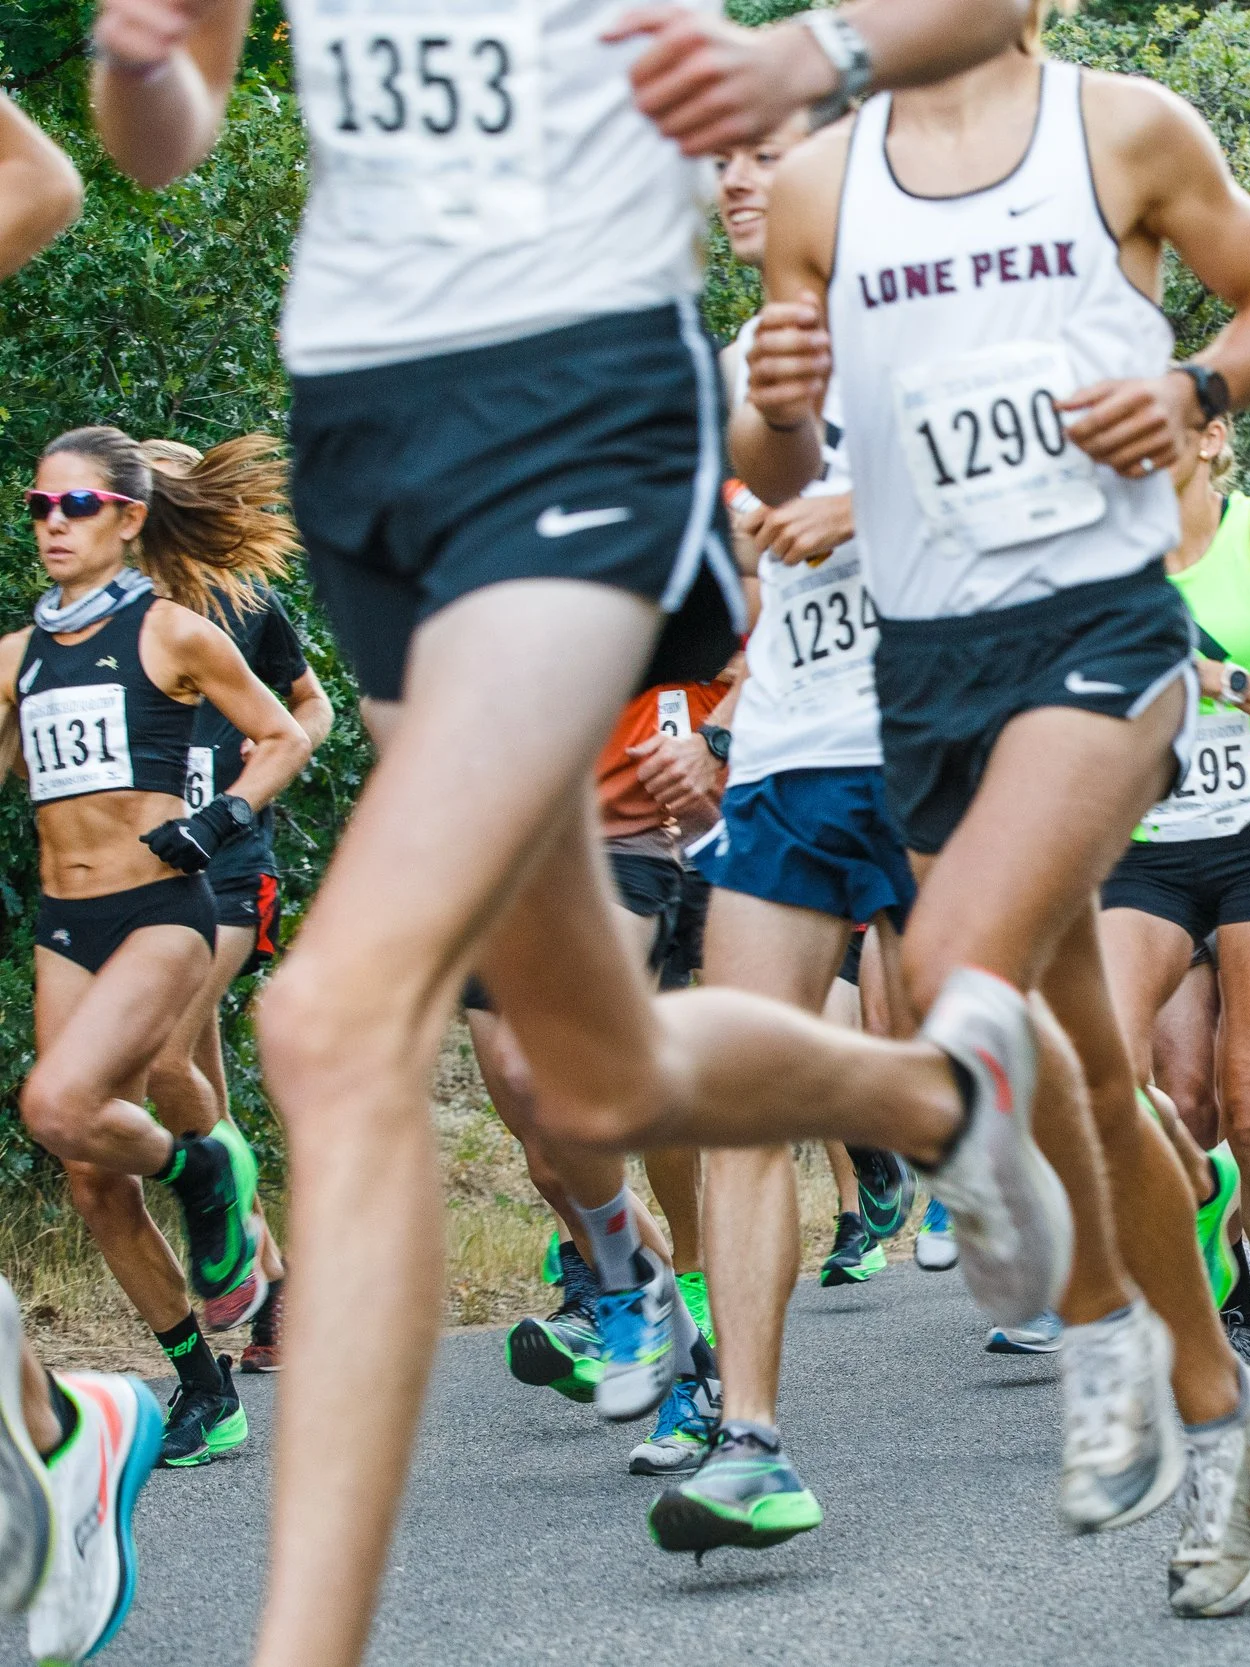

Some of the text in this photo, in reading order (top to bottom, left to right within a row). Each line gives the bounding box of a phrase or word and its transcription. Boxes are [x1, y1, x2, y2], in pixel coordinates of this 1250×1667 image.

[329, 37, 515, 135] 1353
[857, 240, 1078, 310] LONE PEAK
[916, 388, 1067, 488] 1290
[31, 716, 116, 774] 1131
[1174, 744, 1247, 799] 95
